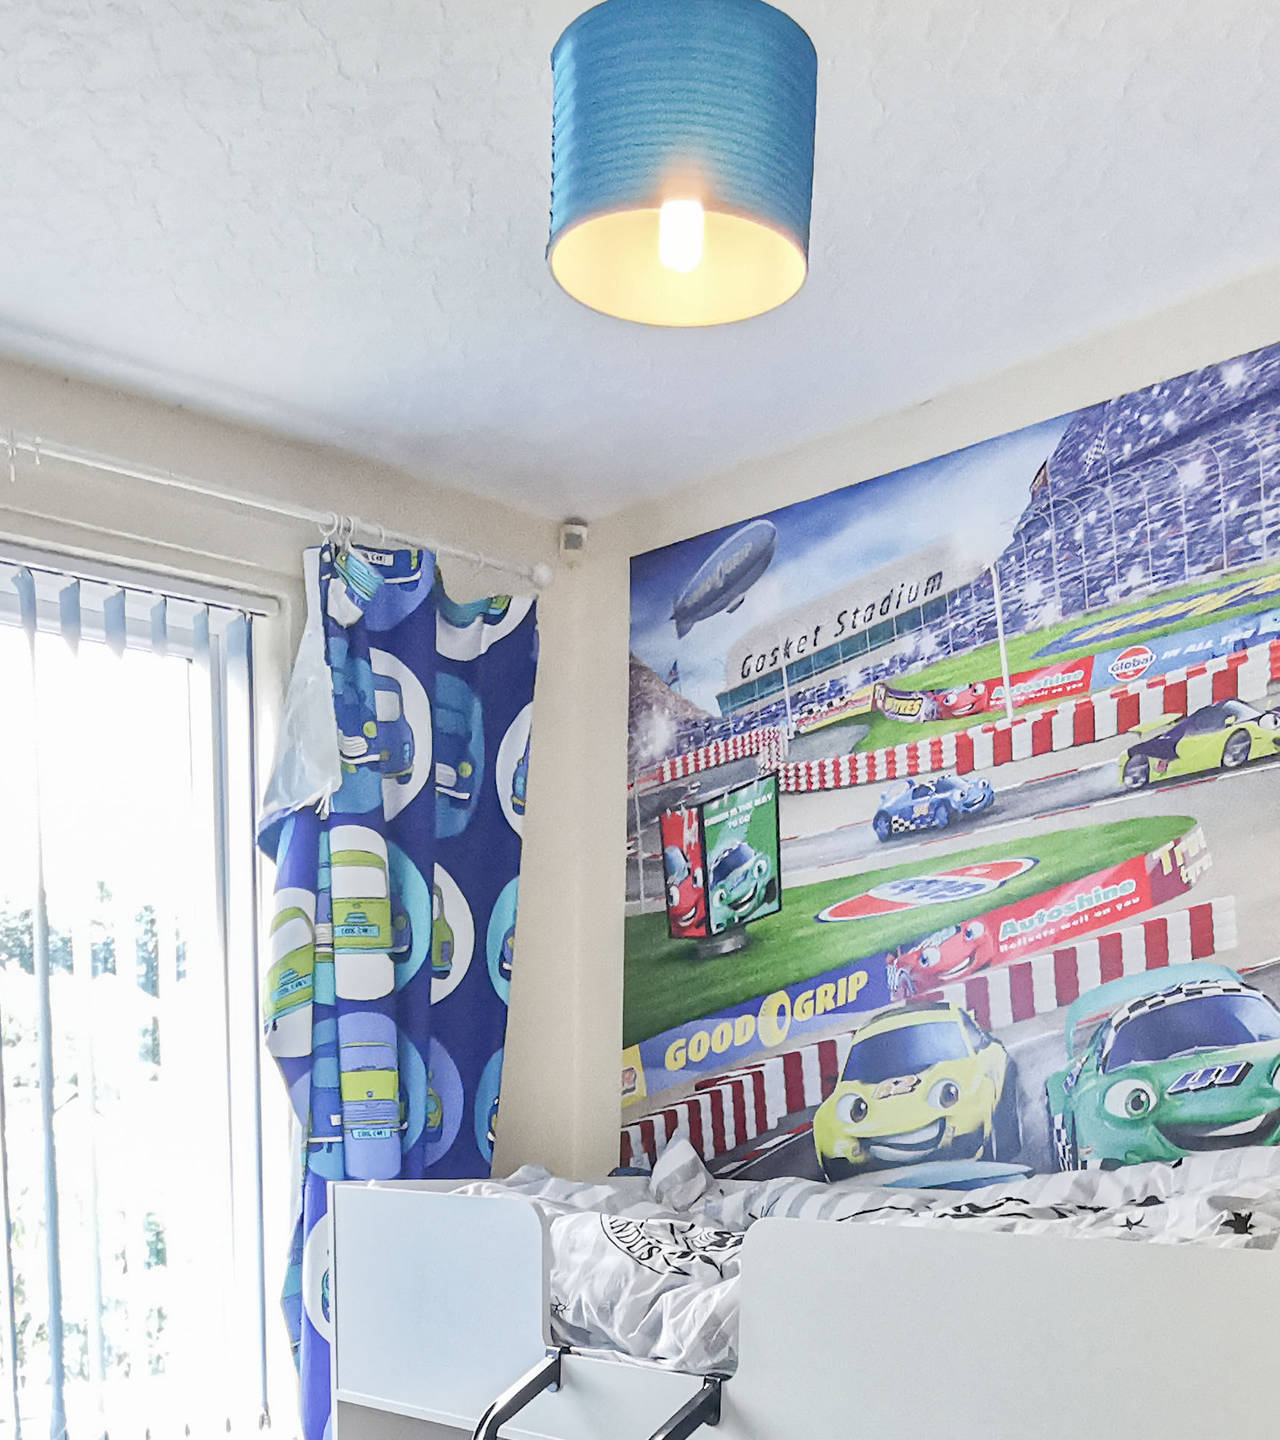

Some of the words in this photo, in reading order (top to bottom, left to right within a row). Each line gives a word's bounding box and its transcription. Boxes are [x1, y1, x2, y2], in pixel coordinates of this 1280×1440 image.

[834, 571, 944, 638] Stadium
[1111, 654, 1154, 672] Global
[999, 879, 1137, 942] Autoshine
[1061, 914, 1090, 930] well
[1094, 907, 1112, 918] on
[664, 1013, 757, 1071] GOOD
[792, 970, 869, 1022] GRIP
